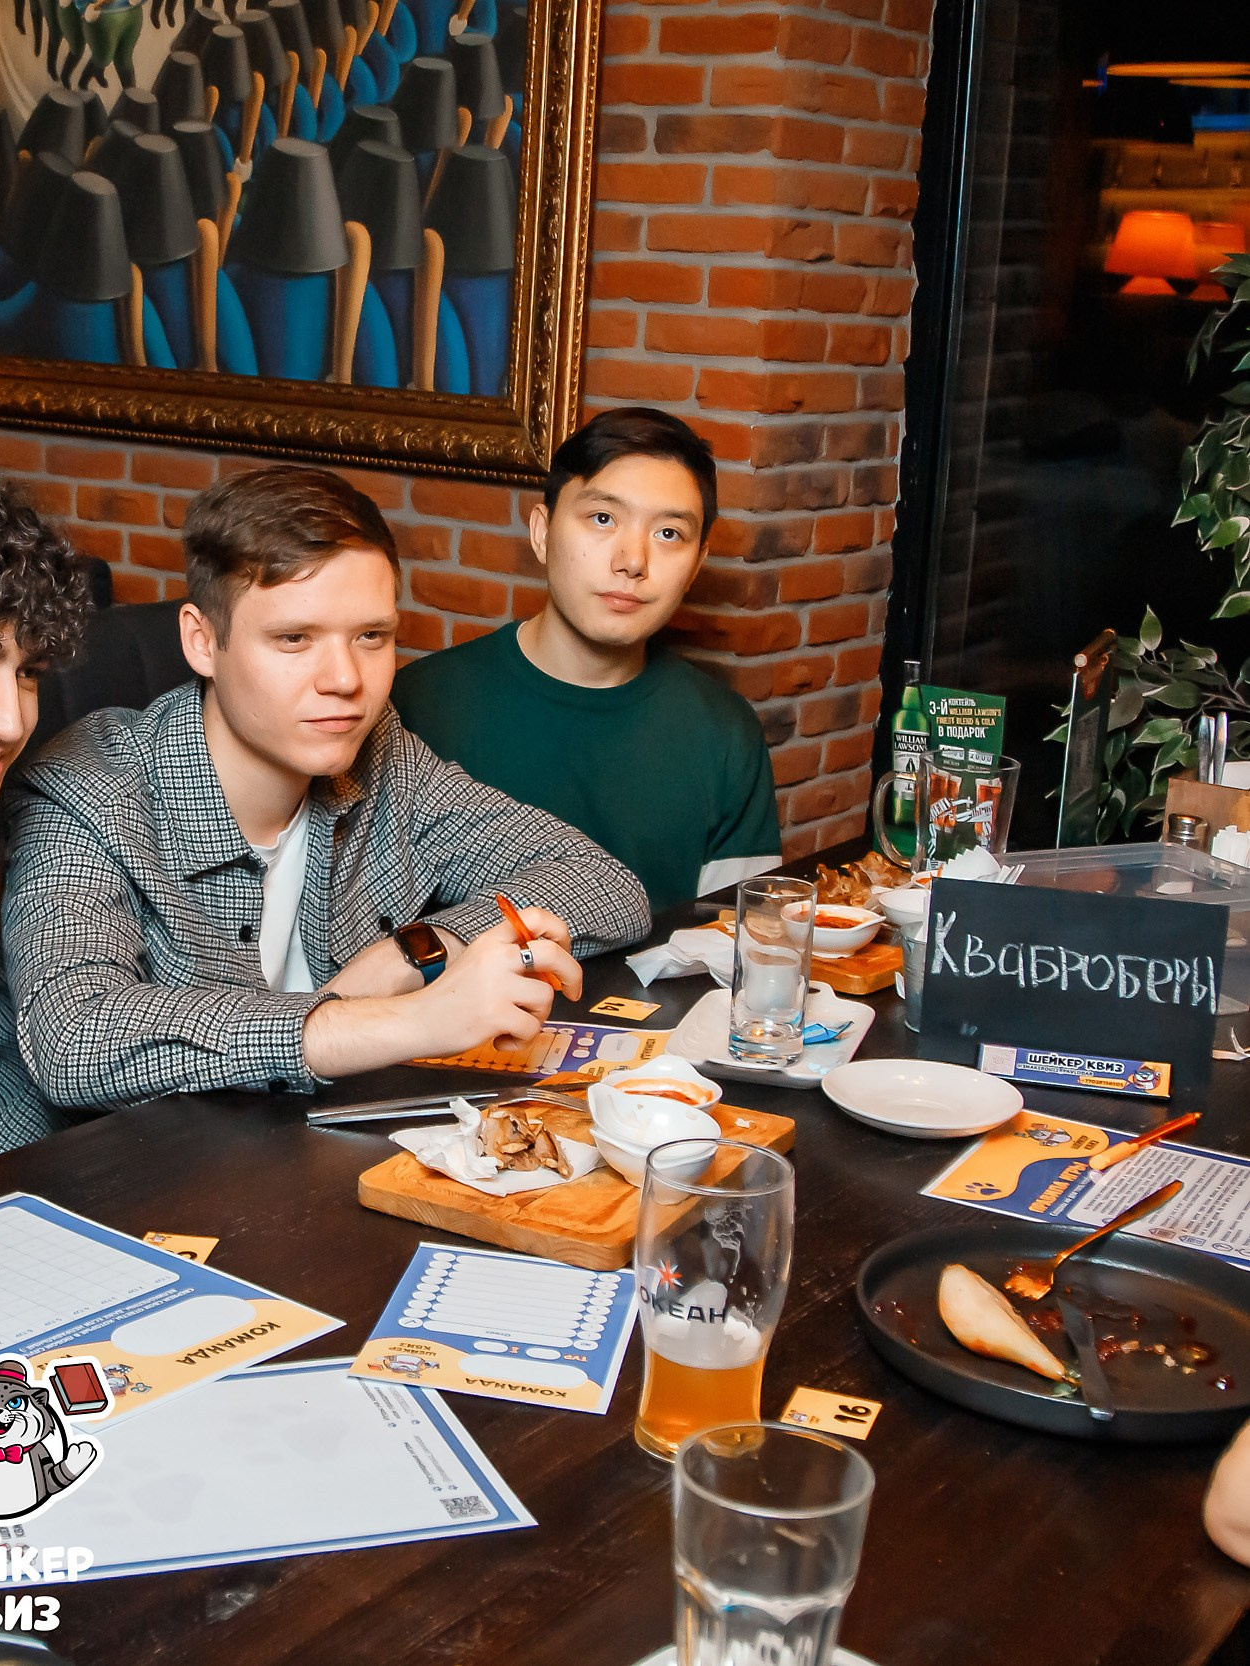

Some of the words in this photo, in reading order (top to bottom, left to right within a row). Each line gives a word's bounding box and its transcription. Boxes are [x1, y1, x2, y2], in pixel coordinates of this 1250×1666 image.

[929, 699, 948, 715] 3-Й
[938, 725, 945, 737] В
[895, 734, 927, 745] WILLIAM
[1028, 1053, 1083, 1069] ШЕЙКЕР
[1086, 1060, 1125, 1073] КВИЗ
[640, 1285, 728, 1325] ОКЕАН
[175, 1321, 281, 1365] КОМАНДА
[400, 1342, 431, 1350] КВИЗ
[389, 1346, 437, 1357] ШЕЙКЕР
[563, 1354, 588, 1362] ТУР
[465, 1378, 568, 1398] КОМАНДА
[833, 1403, 872, 1425] 16
